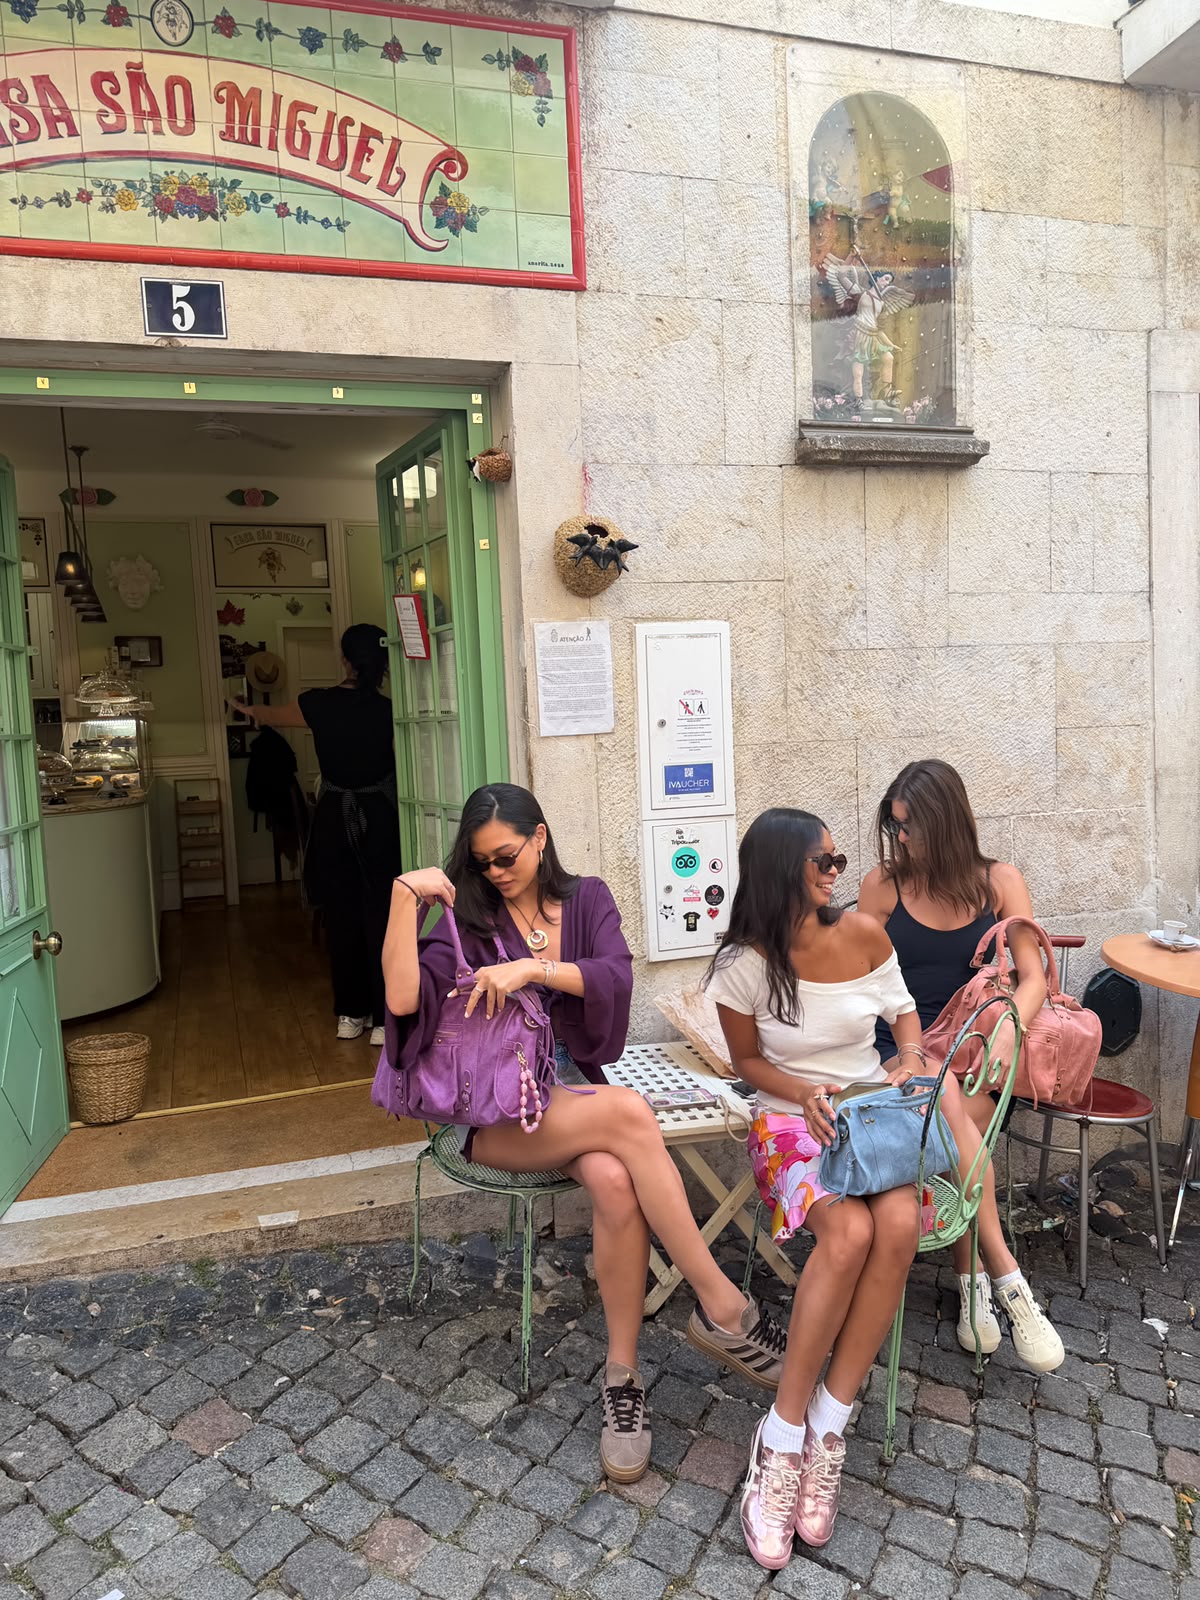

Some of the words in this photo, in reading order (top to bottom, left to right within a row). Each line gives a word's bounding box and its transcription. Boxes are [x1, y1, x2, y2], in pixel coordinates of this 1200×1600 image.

[0, 75, 80, 147] SA
[90, 61, 196, 137] SÃO
[213, 80, 407, 197] MIGUEL
[172, 284, 195, 332] 5
[559, 635, 584, 643] ATENÇÃO
